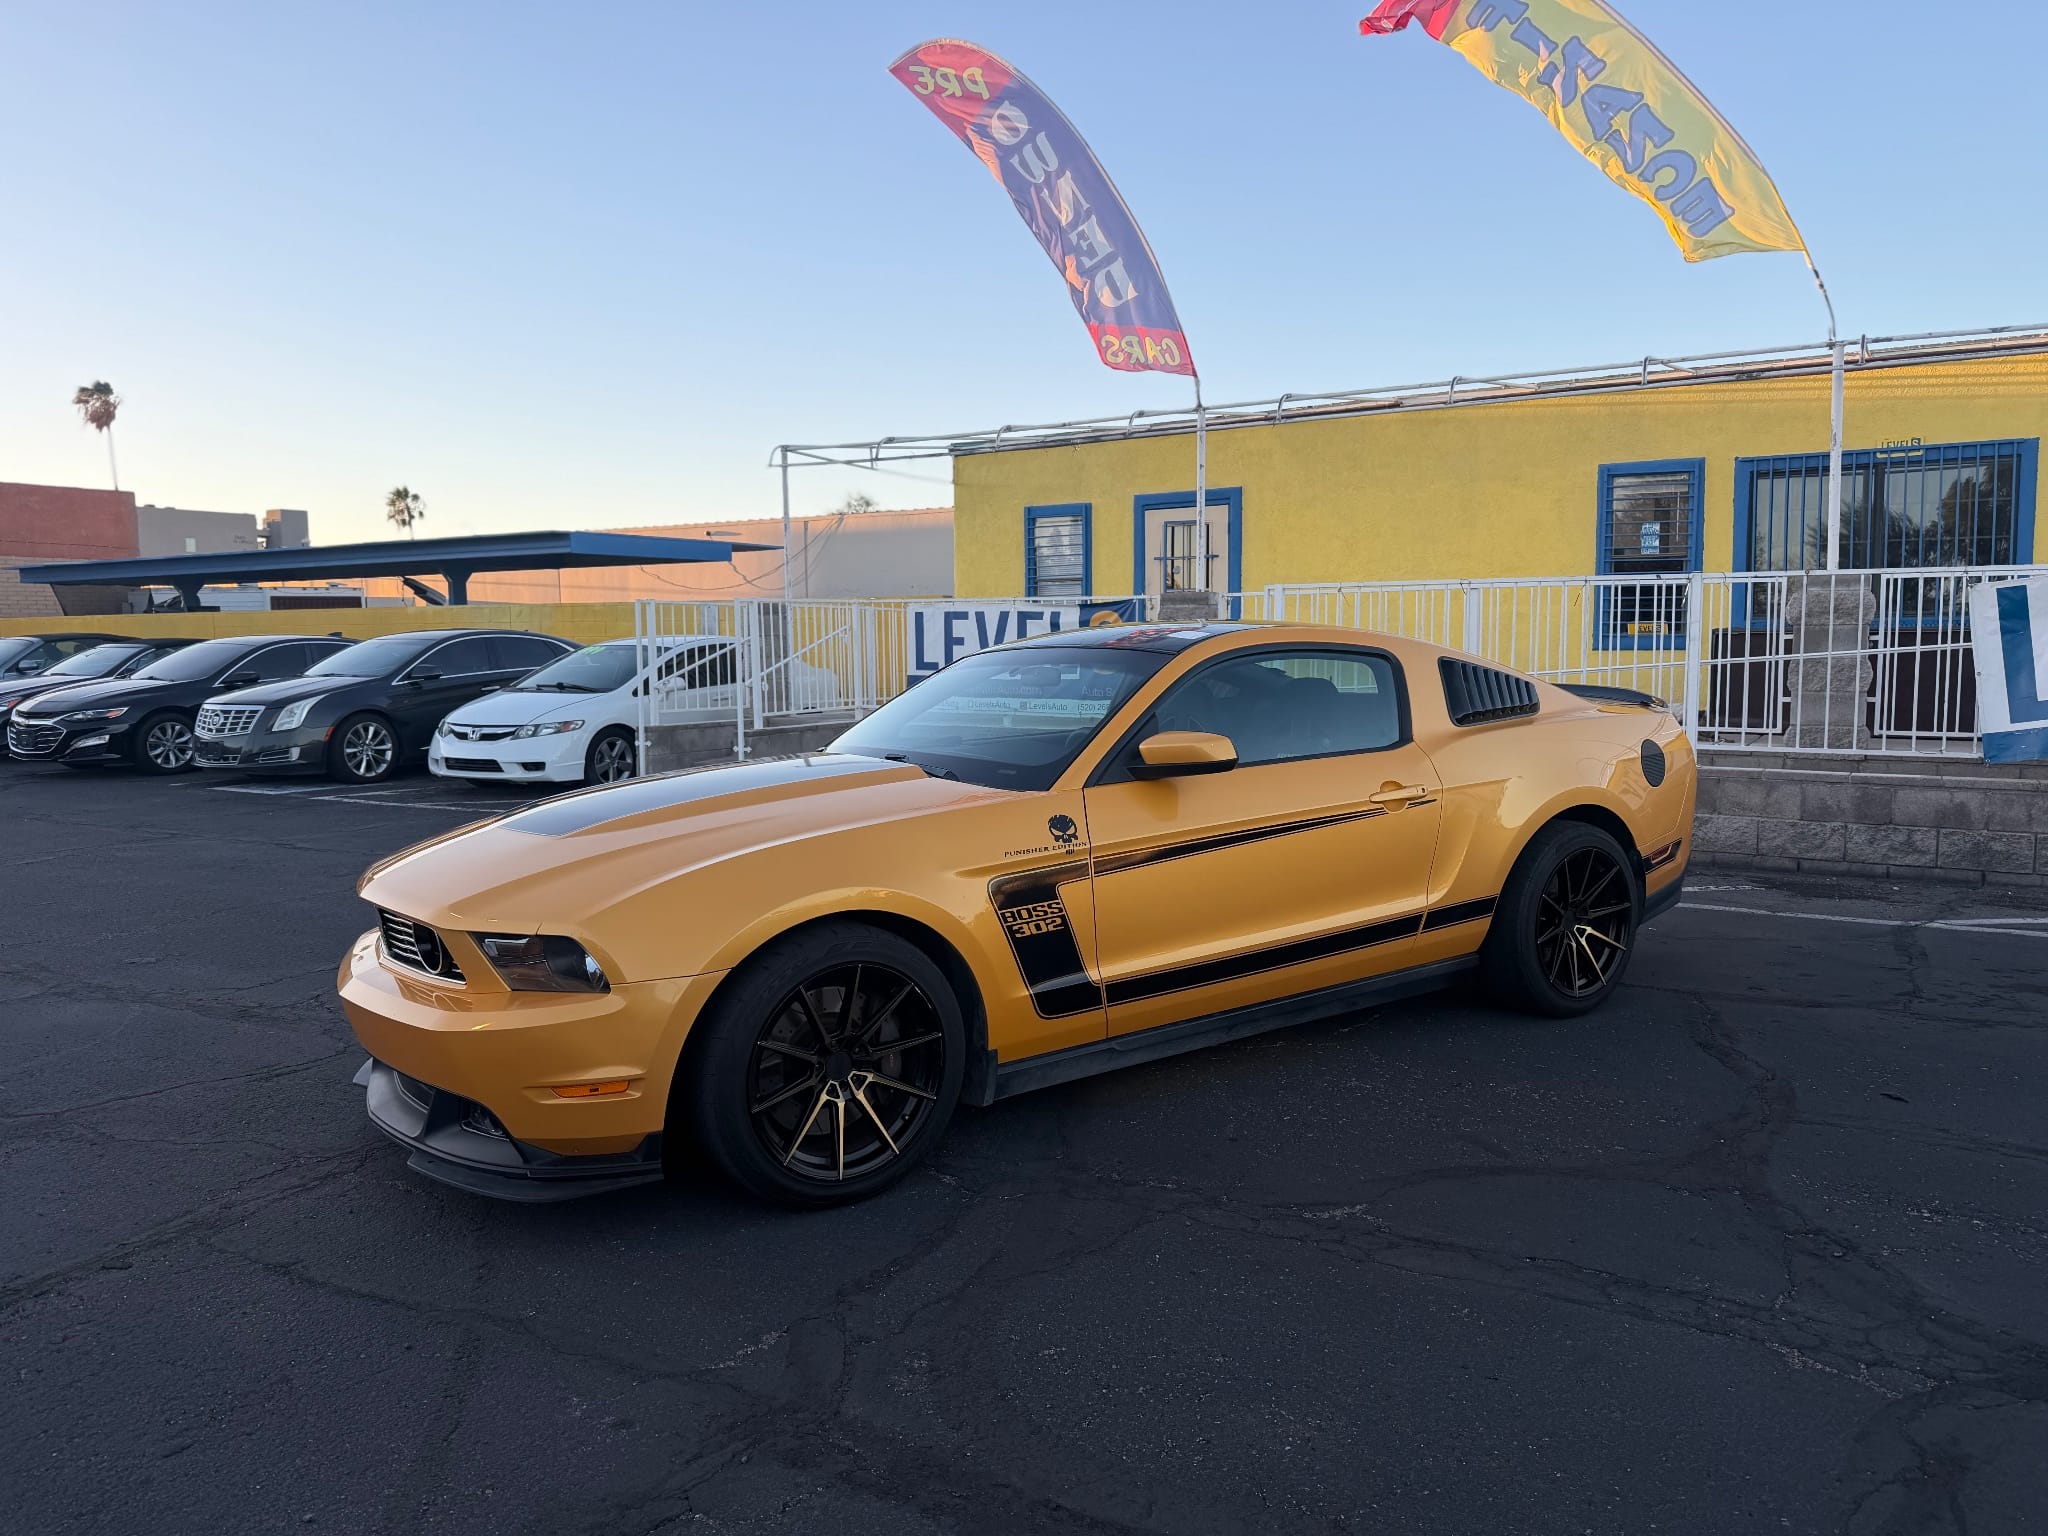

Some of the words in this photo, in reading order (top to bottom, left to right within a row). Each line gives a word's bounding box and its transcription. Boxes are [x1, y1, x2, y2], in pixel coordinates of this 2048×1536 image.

[1636, 624, 1664, 633] EVES
[1004, 846, 1050, 858] PUNISHER
[1052, 841, 1088, 851] EDITION
[1000, 901, 1064, 924] BOSS
[1012, 918, 1064, 938] 302
